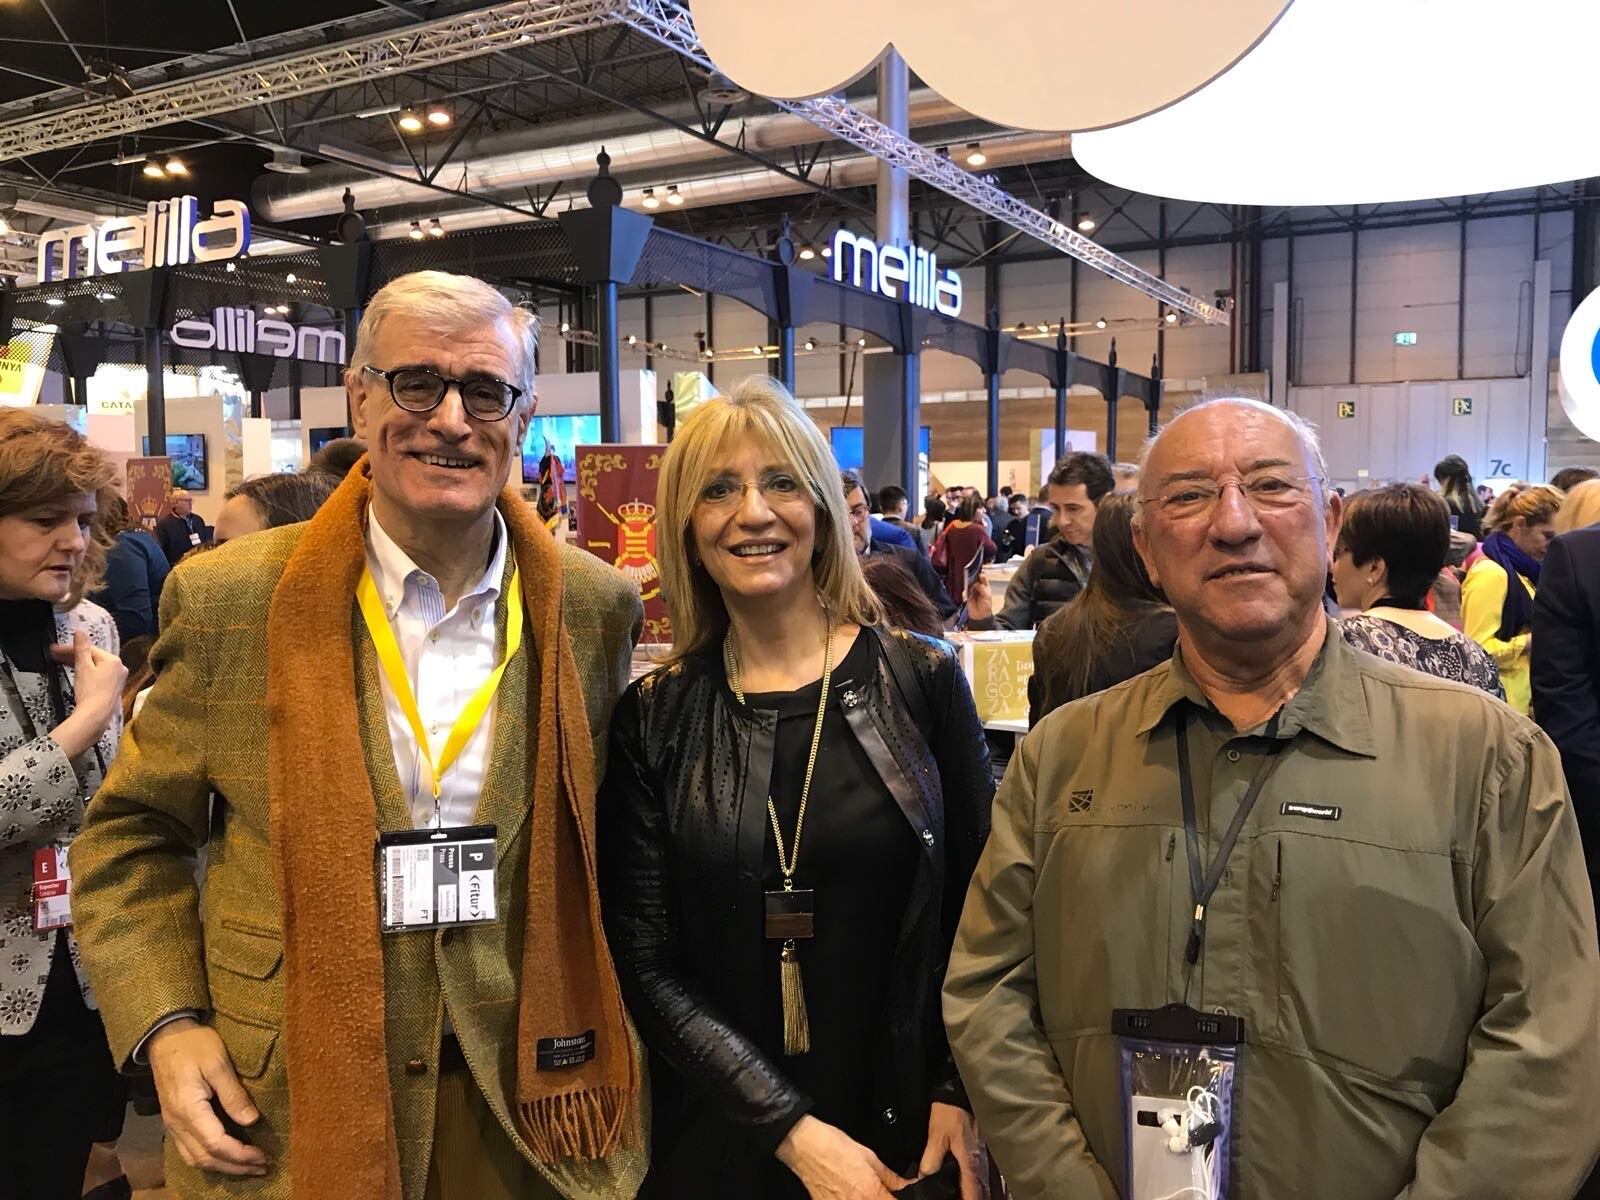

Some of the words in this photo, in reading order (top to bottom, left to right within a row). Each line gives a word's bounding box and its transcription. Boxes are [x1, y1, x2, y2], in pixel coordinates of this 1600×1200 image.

[37, 195, 250, 283] melilla
[833, 229, 963, 318] melilla
[1490, 459, 1511, 476] 7c
[985, 649, 1010, 665] ZA
[988, 665, 1010, 682] RA
[985, 682, 1013, 699] GO
[987, 698, 1011, 716] ZA
[469, 852, 484, 862] P
[41, 862, 48, 874] E
[470, 882, 481, 910] Fitur
[420, 909, 429, 920] FT
